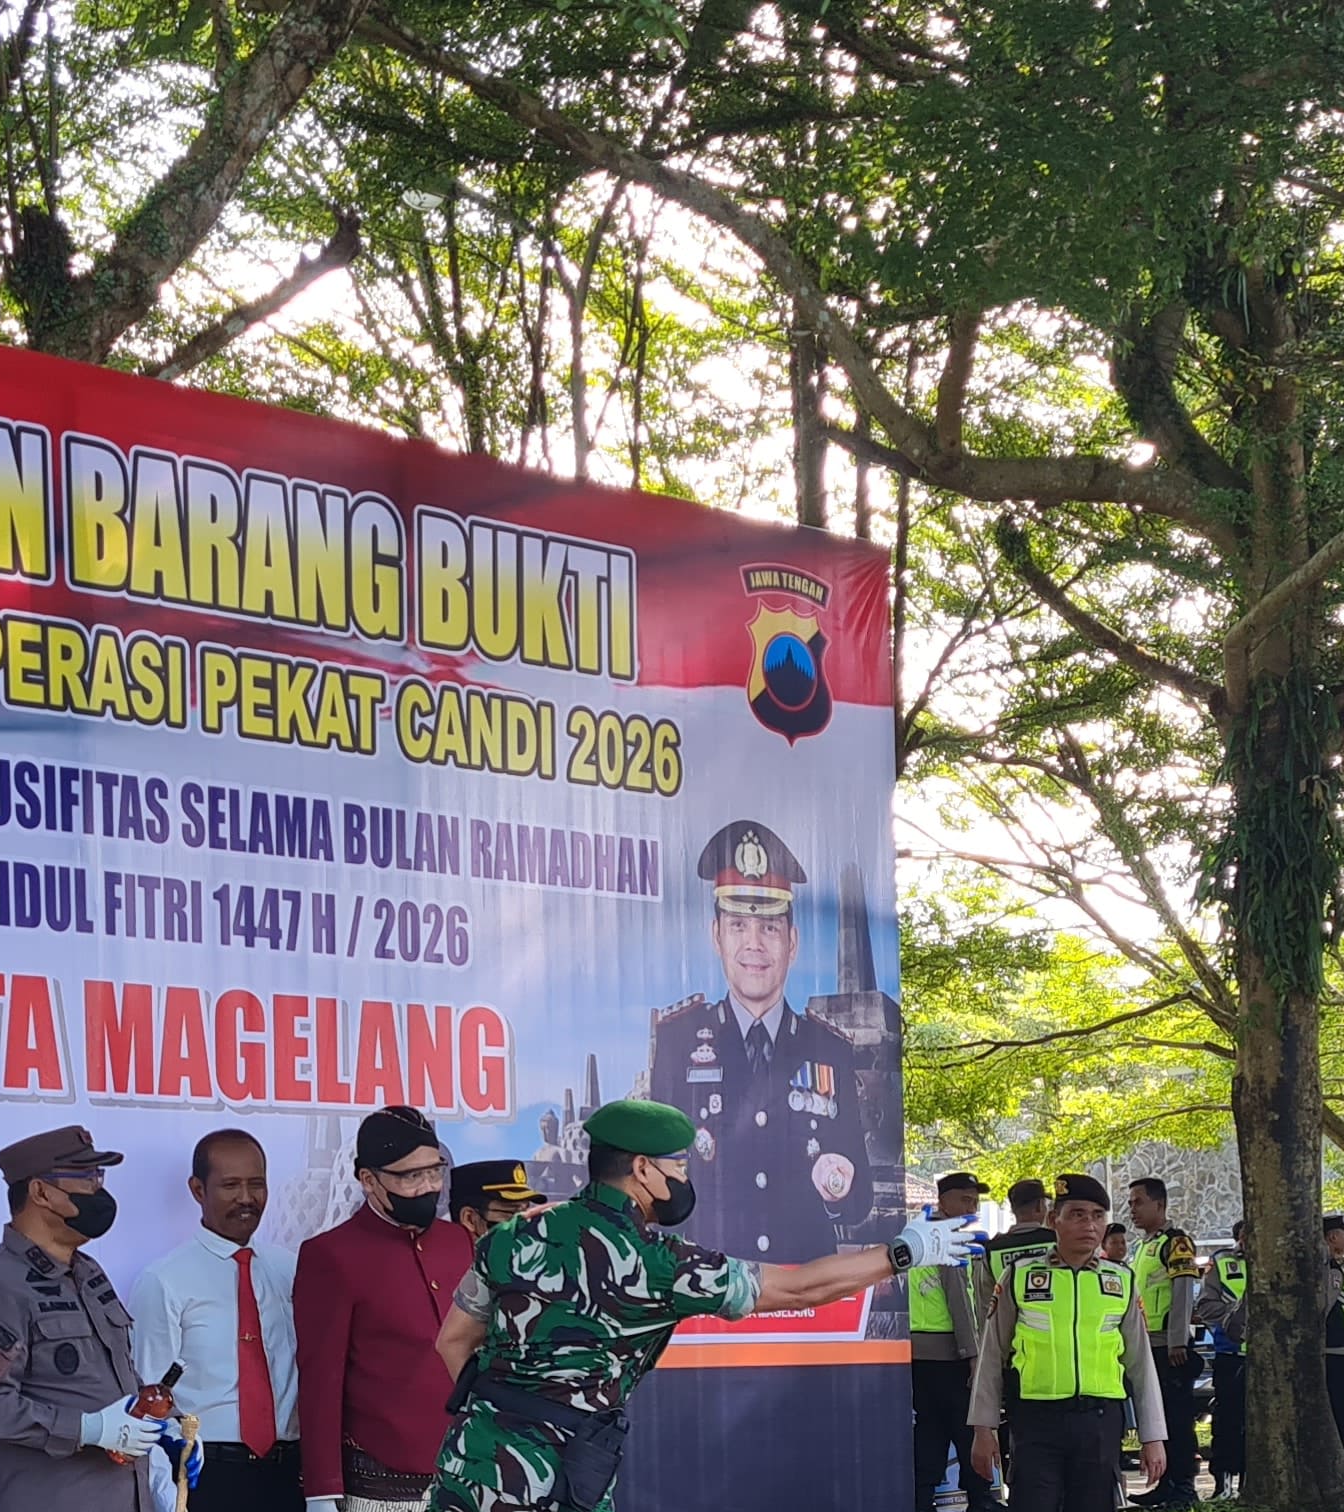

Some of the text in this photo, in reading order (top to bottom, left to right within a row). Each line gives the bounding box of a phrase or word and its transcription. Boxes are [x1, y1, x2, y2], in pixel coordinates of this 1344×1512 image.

[65, 434, 406, 645] BARANG
[416, 508, 635, 680] BUKTI
[749, 570, 825, 601] JAWA TENGAH
[198, 642, 387, 756] PEKAT
[397, 681, 557, 781] CANDI
[567, 708, 682, 796] 2026
[181, 782, 335, 862] SELAMA
[344, 803, 460, 875] BULAN
[470, 818, 660, 897] RAMADHAN
[104, 870, 203, 943] FITRI
[212, 883, 302, 951] 1447
[312, 892, 337, 956] H
[346, 895, 363, 958] /
[374, 898, 470, 966] 2026
[84, 980, 507, 1111] MAGELANG
